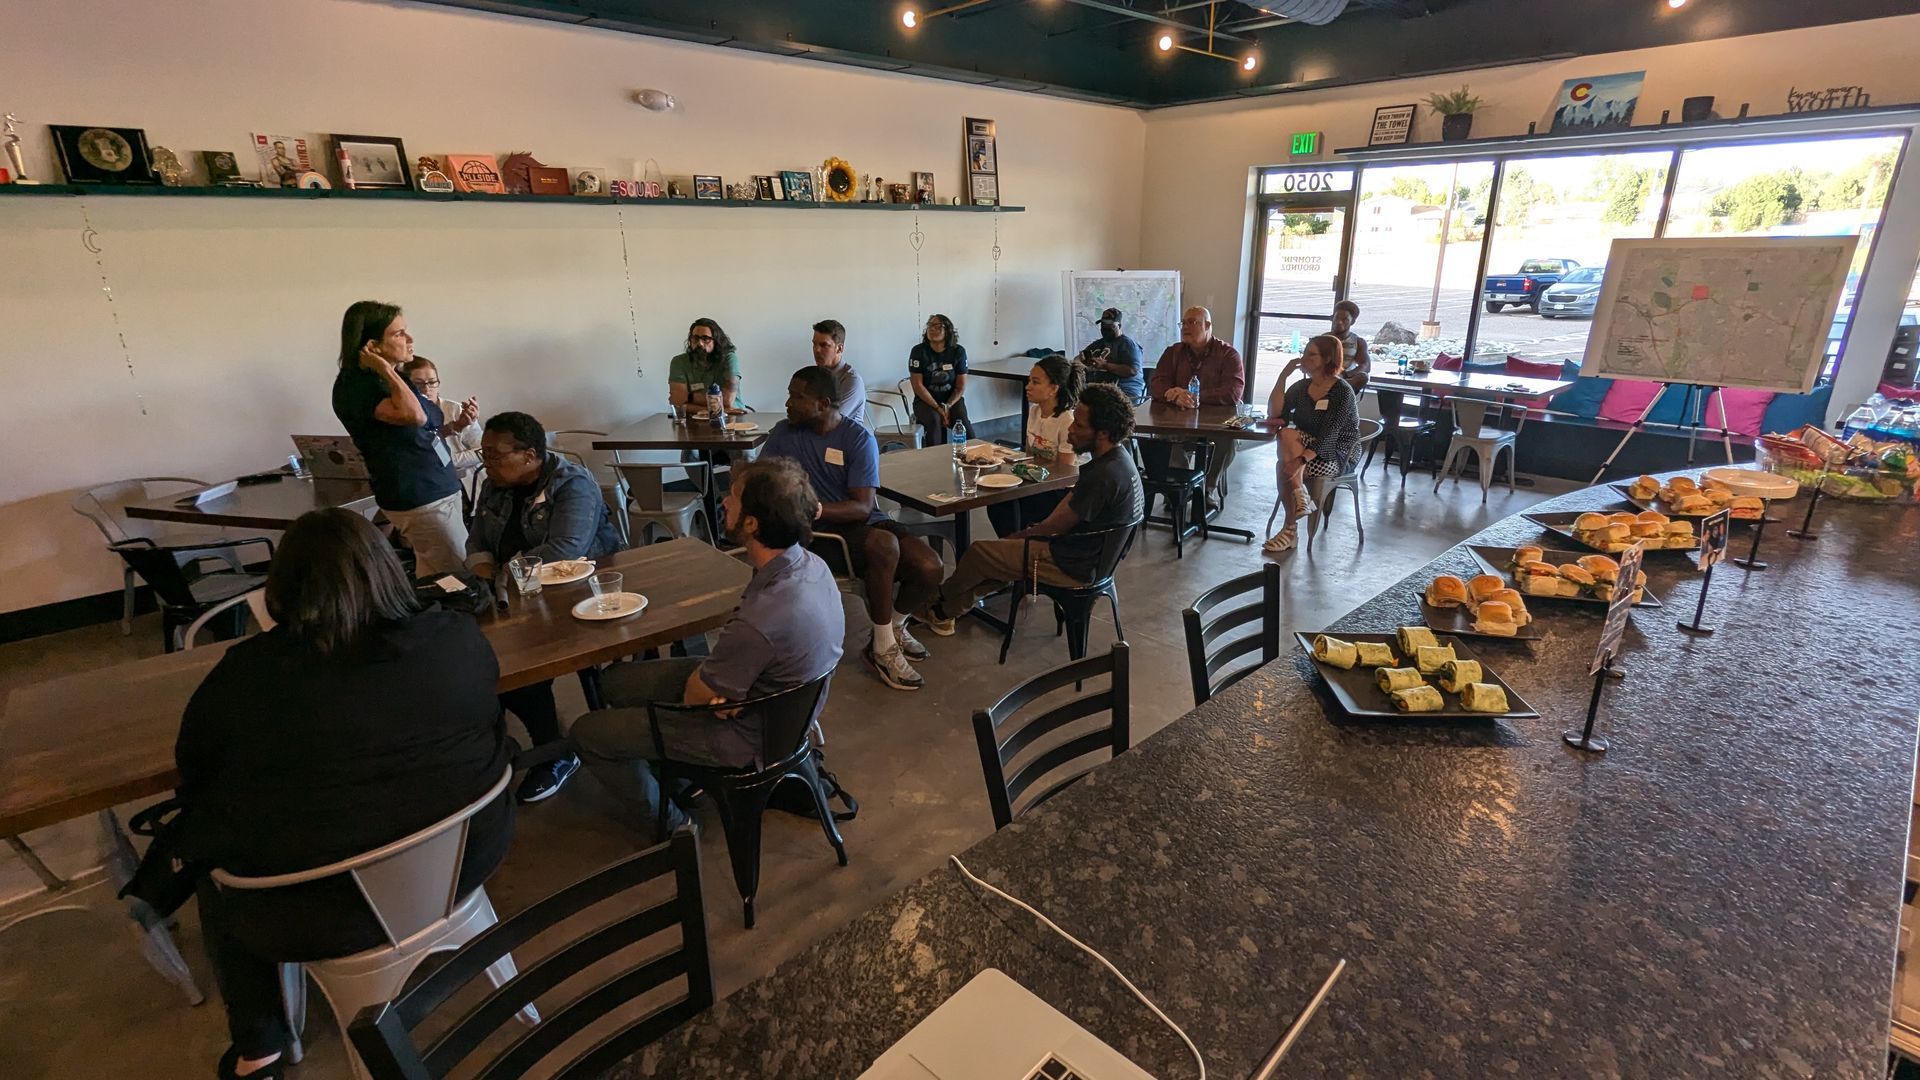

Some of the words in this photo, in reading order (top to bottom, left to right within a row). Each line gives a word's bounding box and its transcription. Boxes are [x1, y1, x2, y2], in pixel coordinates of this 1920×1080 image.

[1389, 120, 1408, 128] TOWEL
[1292, 133, 1316, 154] EXIT
[610, 180, 660, 198] #SQUAD
